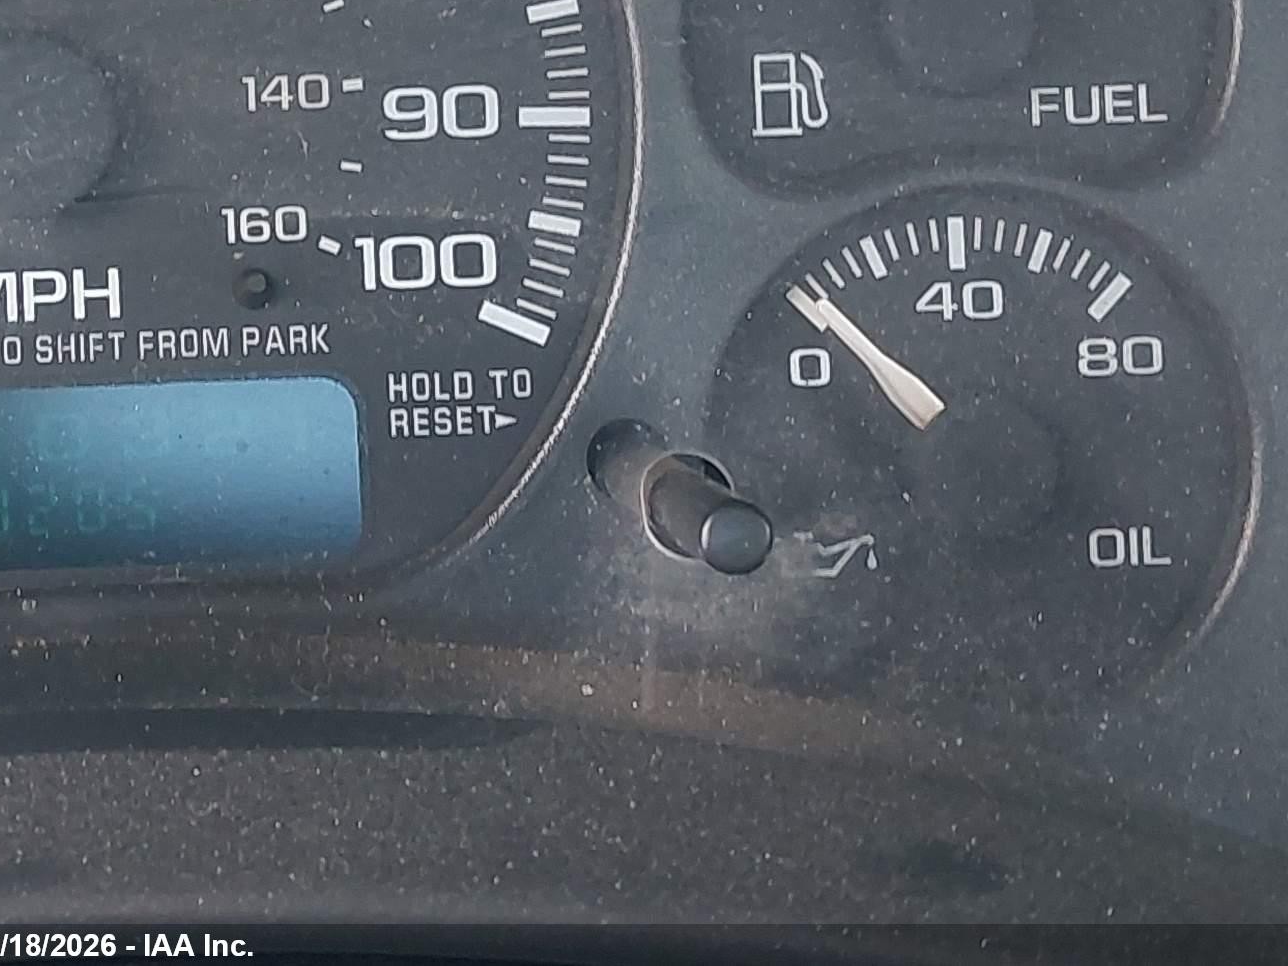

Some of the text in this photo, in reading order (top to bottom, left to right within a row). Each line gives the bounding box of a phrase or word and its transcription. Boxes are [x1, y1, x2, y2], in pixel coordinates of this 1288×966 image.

[241, 74, 330, 112] 140
[383, 84, 499, 140] 90
[1030, 83, 1168, 127] FUEL
[221, 205, 307, 244] 160
[354, 233, 497, 291] 100
[915, 280, 1003, 321] 40
[35, 331, 125, 363] SHIFT
[139, 327, 229, 360] FROM
[242, 323, 329, 356] PARK
[1078, 336, 1163, 377] 80
[388, 368, 531, 403] HOLD TO
[789, 348, 831, 387] 0
[389, 404, 493, 438] RESET
[1089, 526, 1172, 567] OIL
